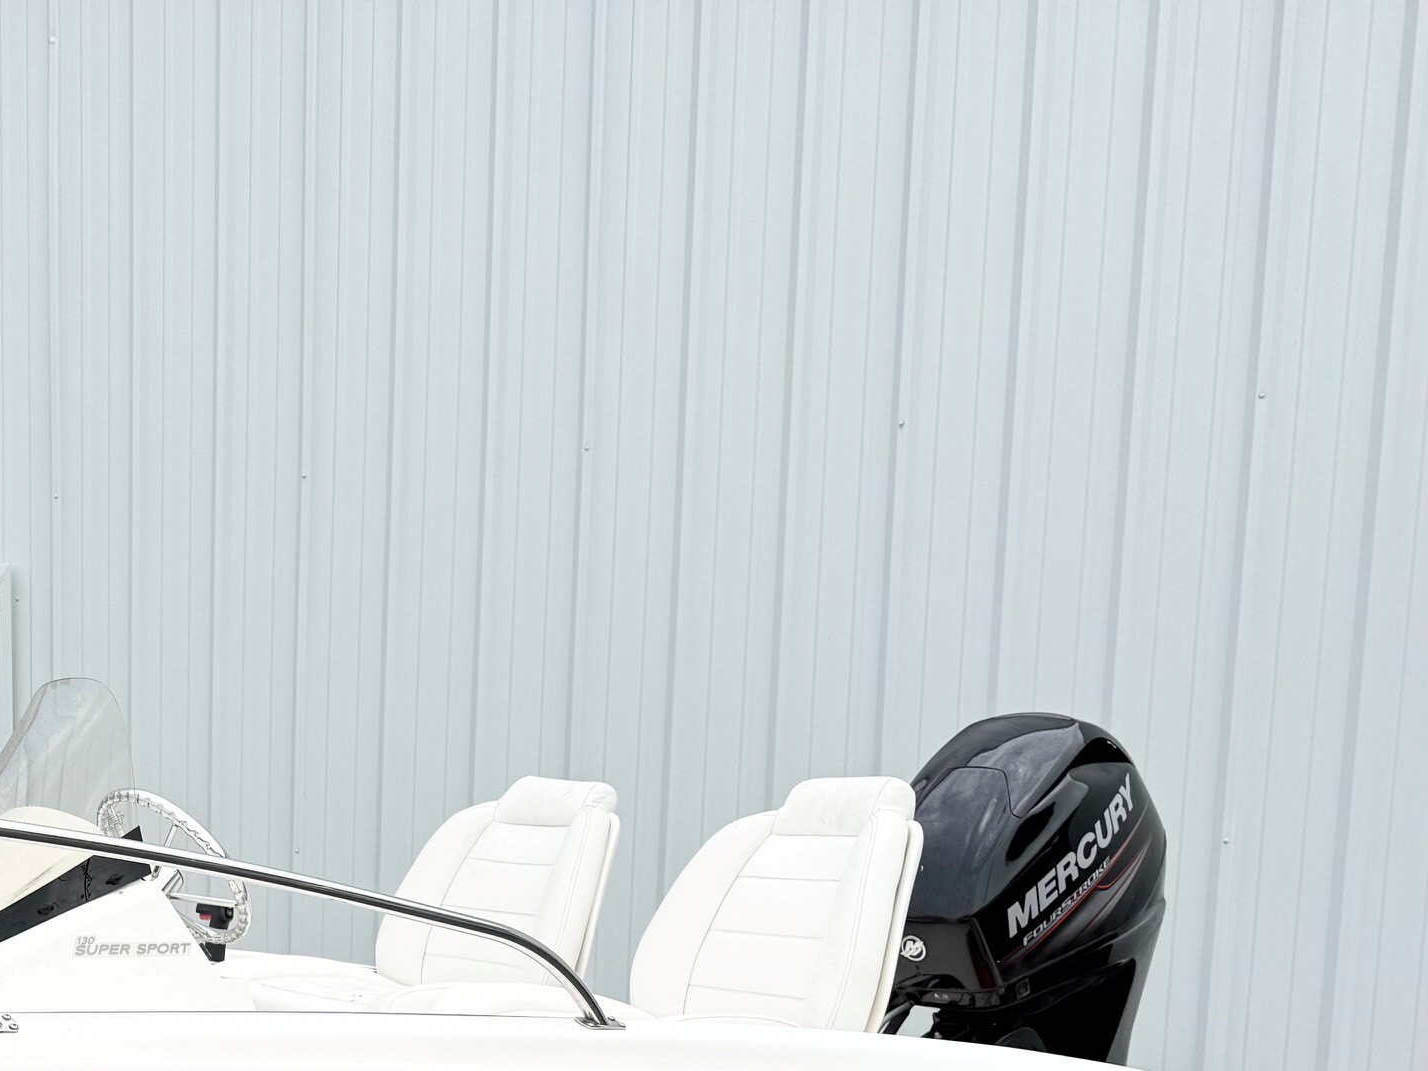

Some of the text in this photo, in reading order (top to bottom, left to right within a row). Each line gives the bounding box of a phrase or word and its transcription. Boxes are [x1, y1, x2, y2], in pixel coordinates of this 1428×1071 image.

[1007, 772, 1134, 939] MERCURY
[1023, 855, 1112, 947] FOURSTROKE
[75, 942, 192, 956] SUPER SPORT
[76, 936, 95, 945] 130
